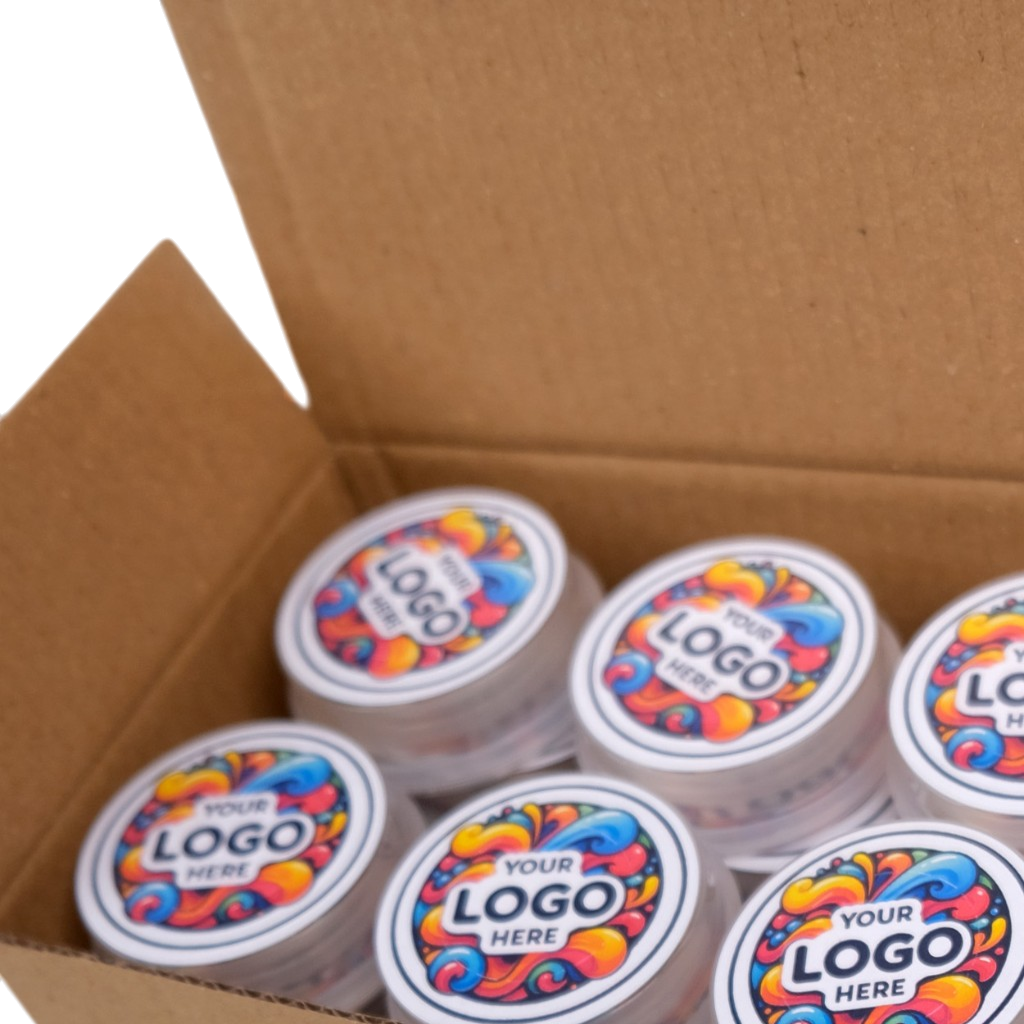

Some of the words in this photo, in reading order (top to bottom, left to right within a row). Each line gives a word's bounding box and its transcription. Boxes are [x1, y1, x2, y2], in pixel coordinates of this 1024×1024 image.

[377, 551, 461, 637] LOGO
[723, 607, 775, 643] YOUR
[658, 611, 781, 691] LOGO
[667, 658, 717, 695] HERE
[204, 799, 268, 817] YOUR
[153, 820, 305, 861] LOGO
[187, 863, 249, 880] HERE
[505, 857, 574, 875] YOUR
[453, 881, 616, 924] LOGO
[840, 904, 913, 929] YOUR
[490, 928, 558, 947] HERE
[792, 927, 963, 982] LOGO
[835, 979, 906, 1003] HERE
